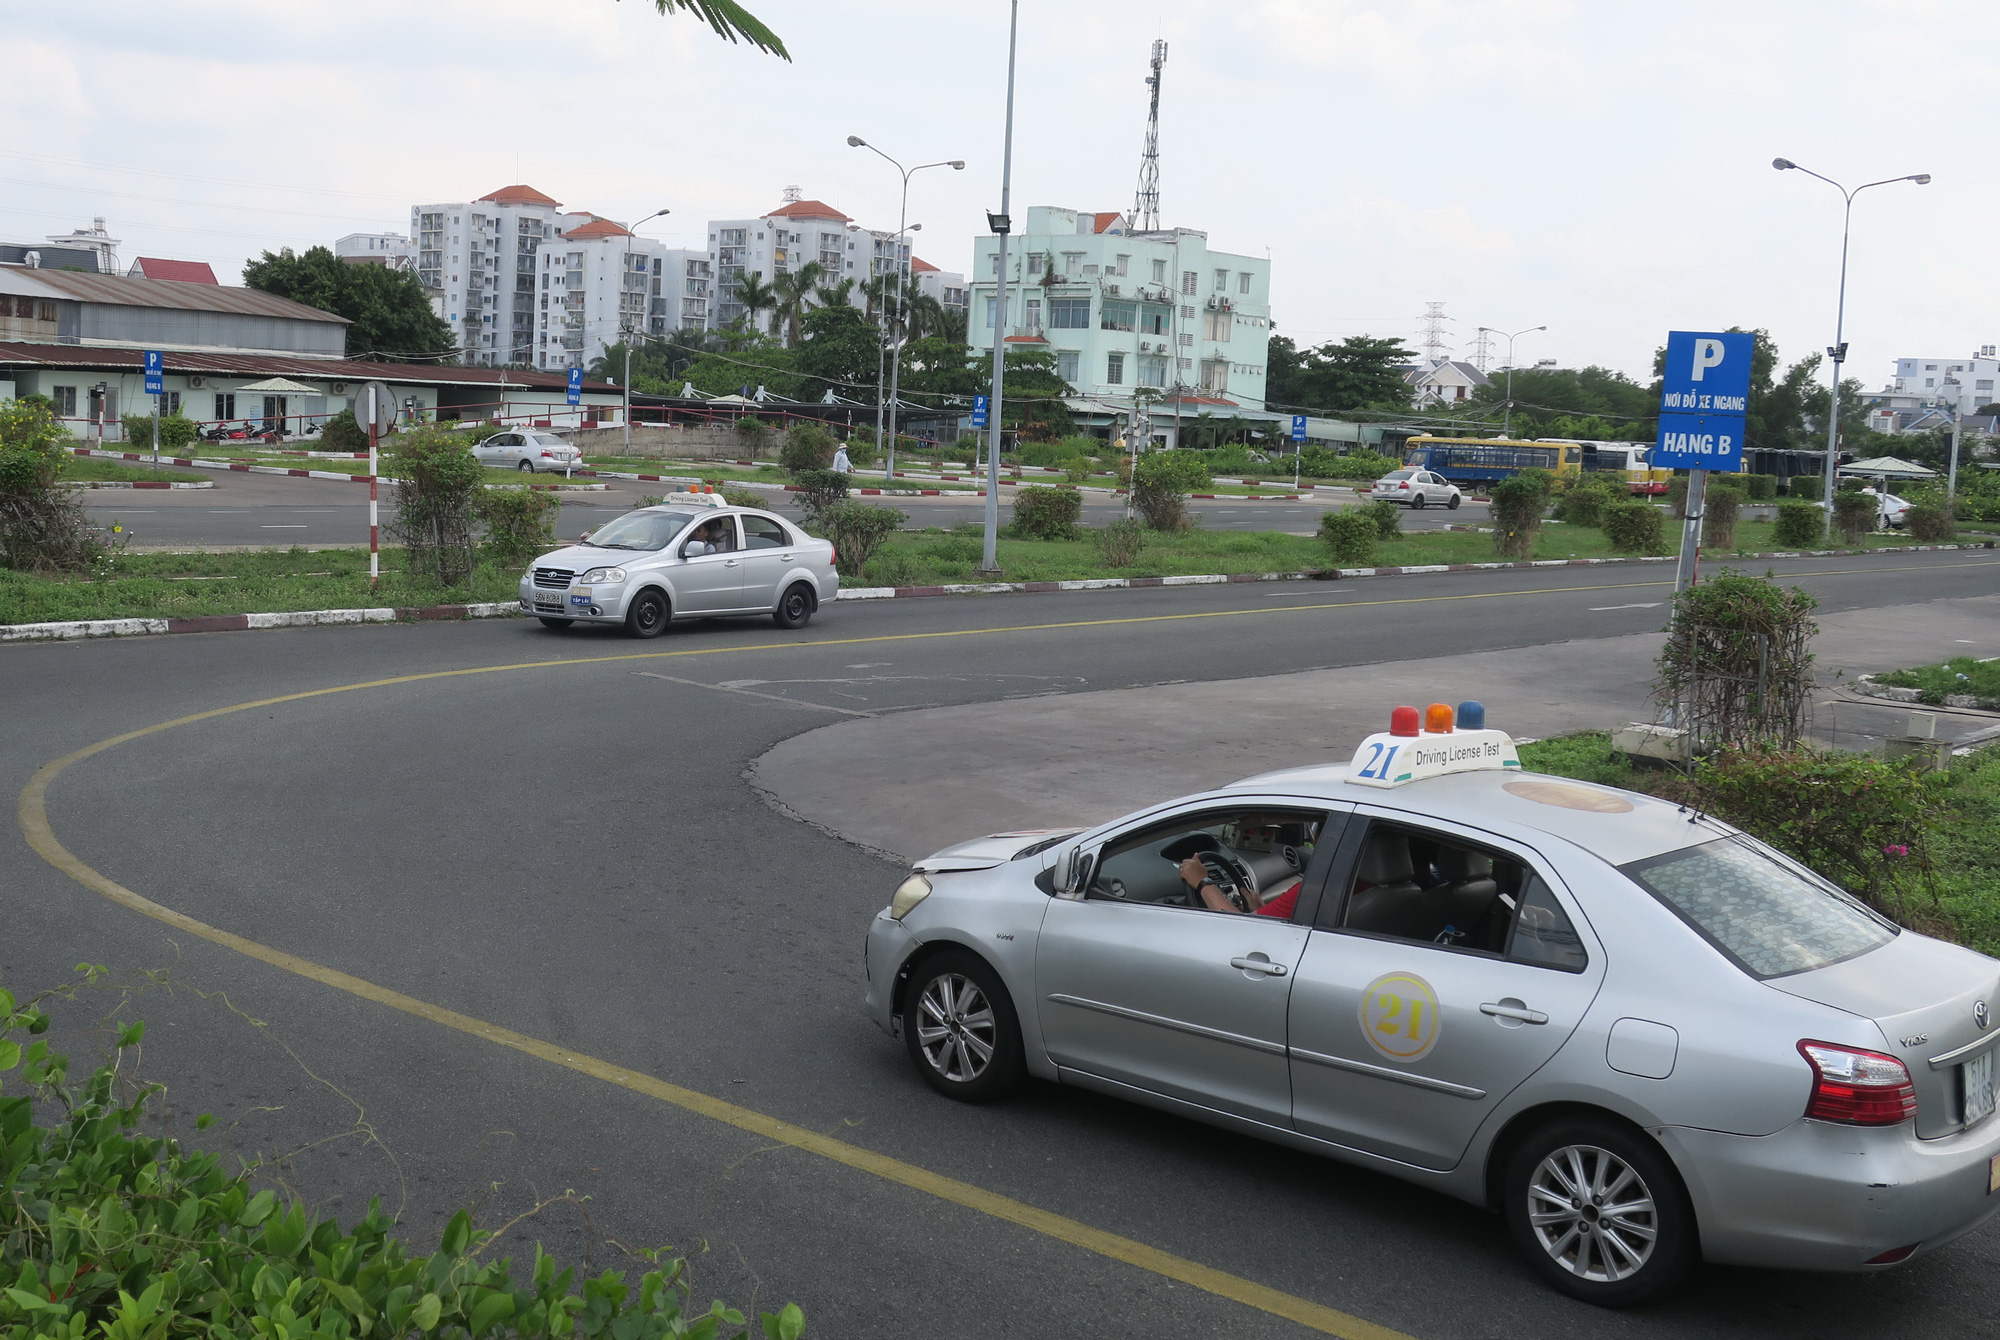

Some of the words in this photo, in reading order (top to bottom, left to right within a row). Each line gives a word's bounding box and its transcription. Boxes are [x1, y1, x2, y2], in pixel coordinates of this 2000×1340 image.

[150, 353, 157, 367] P
[1691, 338, 1725, 381] P
[572, 370, 579, 381] P
[978, 397, 984, 407] P
[1664, 391, 1681, 407] NƠI
[1682, 388, 1697, 408] ĐỖ
[1698, 394, 1711, 409] XE
[1713, 395, 1745, 411] NGANG
[1296, 417, 1303, 425] P
[1663, 432, 1713, 457] HẠNG
[1717, 435, 1732, 455] B
[1357, 742, 1401, 781] 21
[1416, 746, 1447, 766] Driving
[1449, 746, 1481, 762] License
[1483, 742, 1500, 757] Test
[1375, 993, 1423, 1041] 21
[1899, 1033, 1928, 1048] VIOS
[1971, 1055, 1986, 1088] 51A
